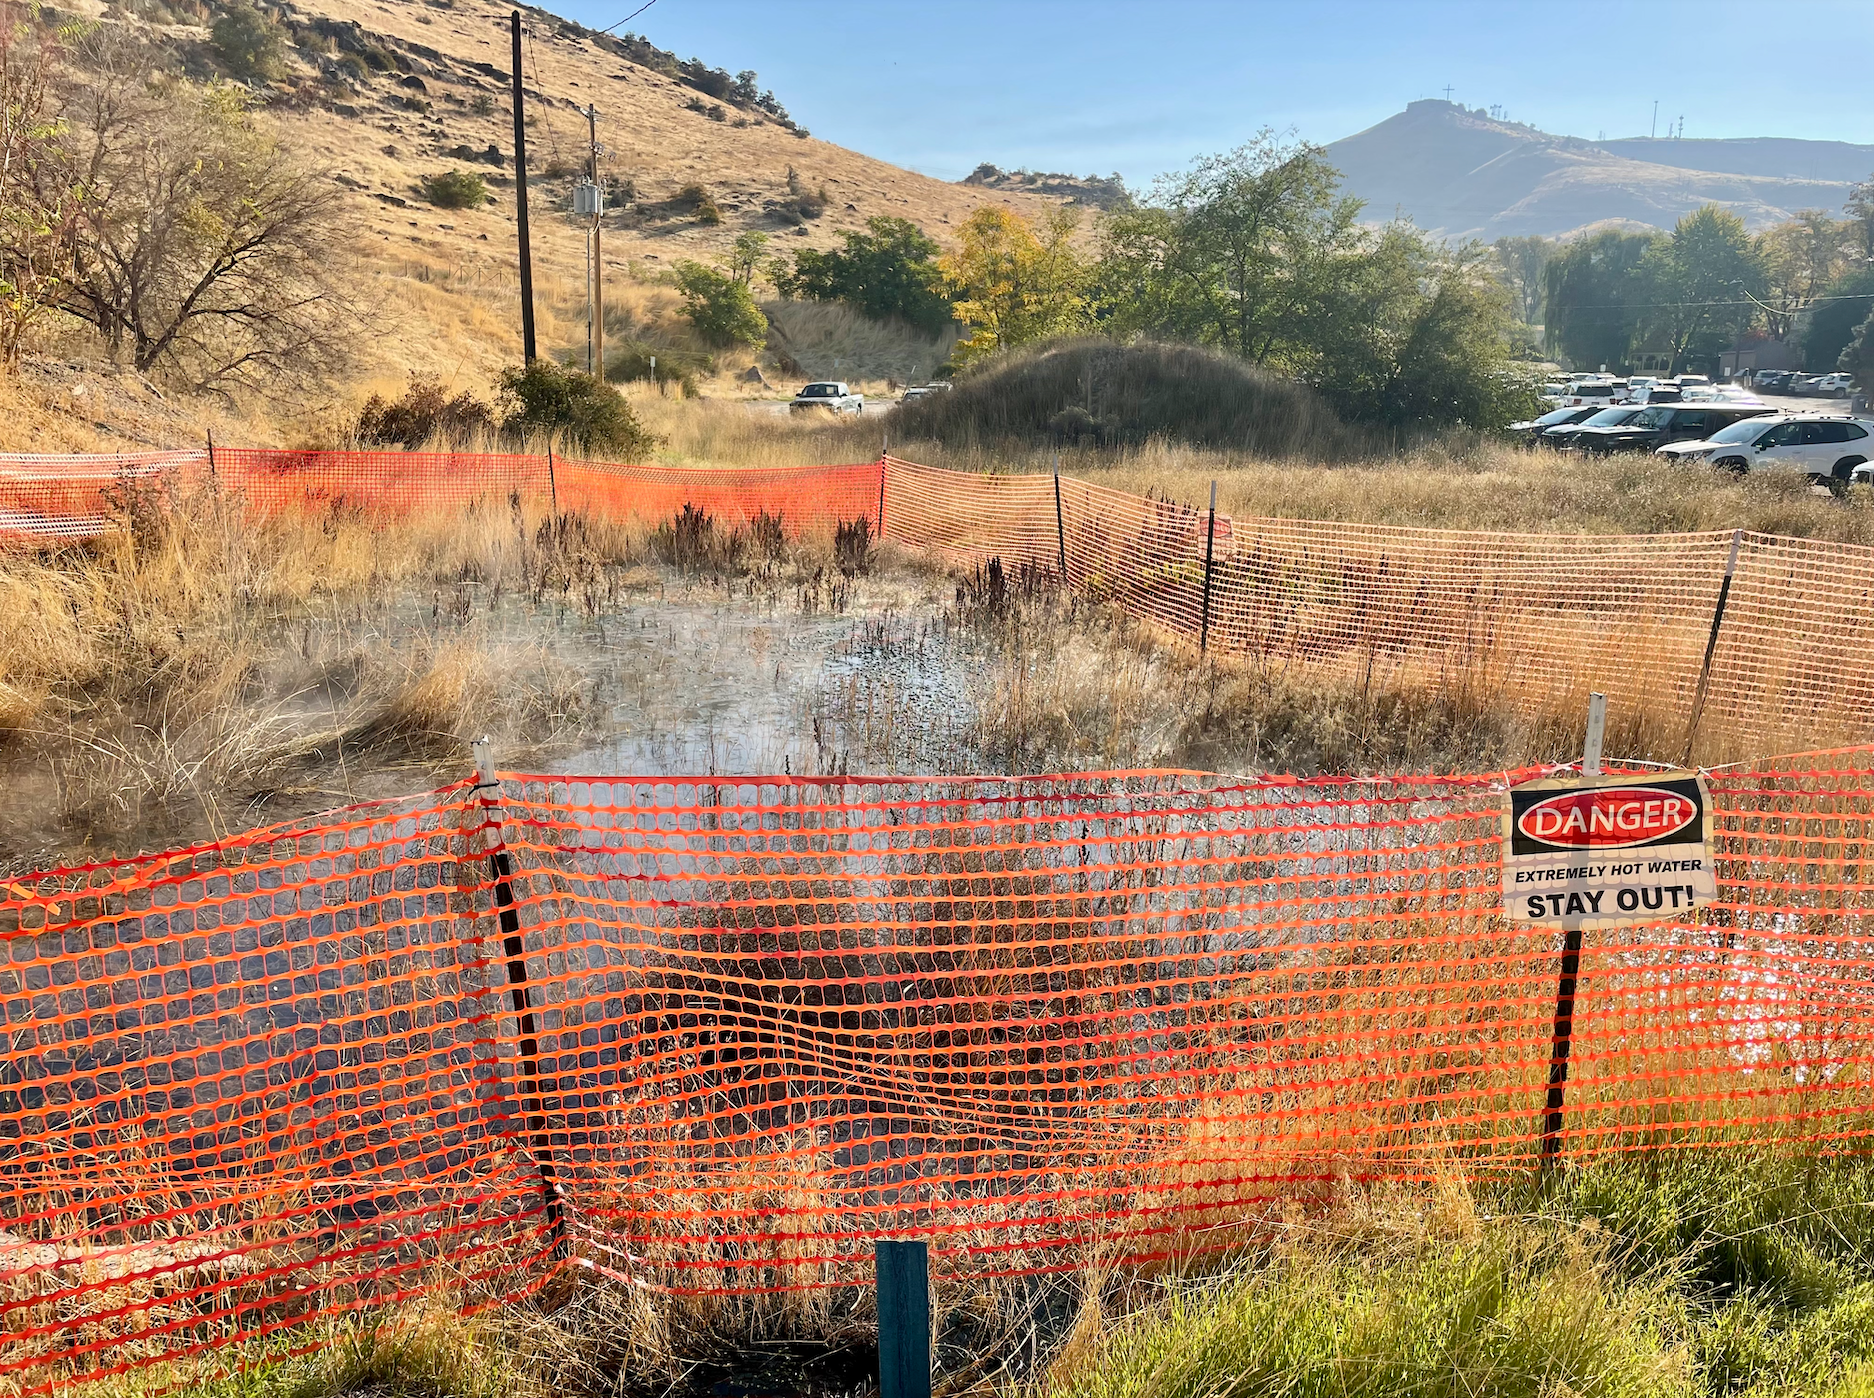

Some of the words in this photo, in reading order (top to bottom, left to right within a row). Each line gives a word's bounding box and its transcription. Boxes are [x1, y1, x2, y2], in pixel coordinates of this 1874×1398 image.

[1535, 798, 1682, 836] DANGER
[1515, 865, 1606, 883] EXTREMELY
[1611, 863, 1644, 876] HOT
[1648, 859, 1702, 873] WATER
[1527, 890, 1605, 918] STAY
[1616, 885, 1695, 911] OUT!
